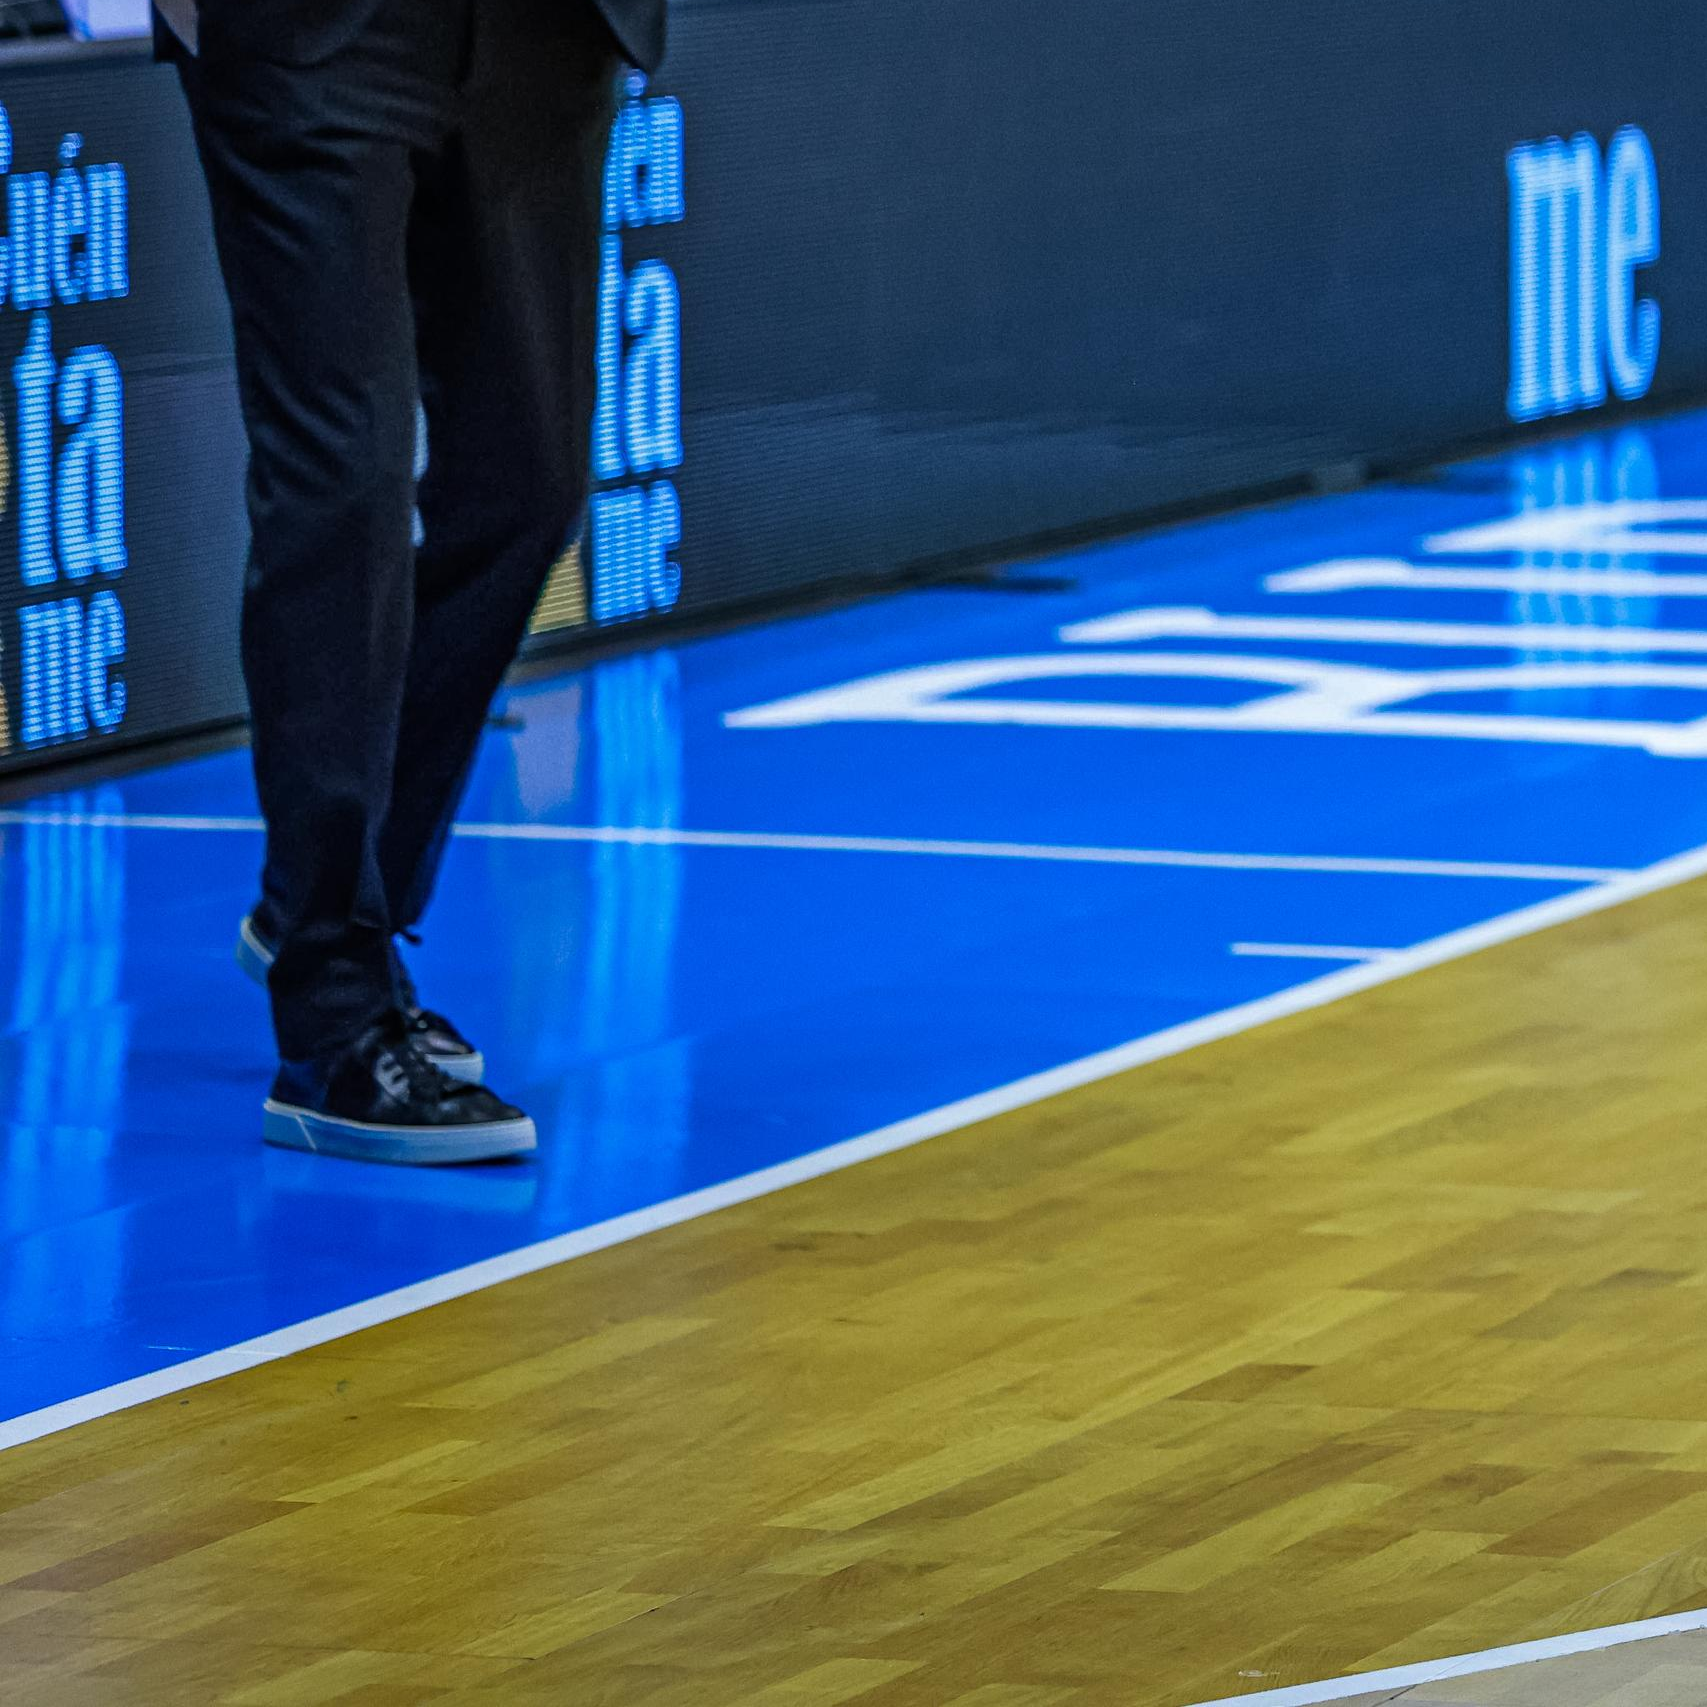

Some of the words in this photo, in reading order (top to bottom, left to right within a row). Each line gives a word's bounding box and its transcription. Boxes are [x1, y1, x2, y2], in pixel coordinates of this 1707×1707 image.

[1507, 124, 1661, 423] me
[12, 307, 128, 587] ta
[17, 589, 128, 750] me
